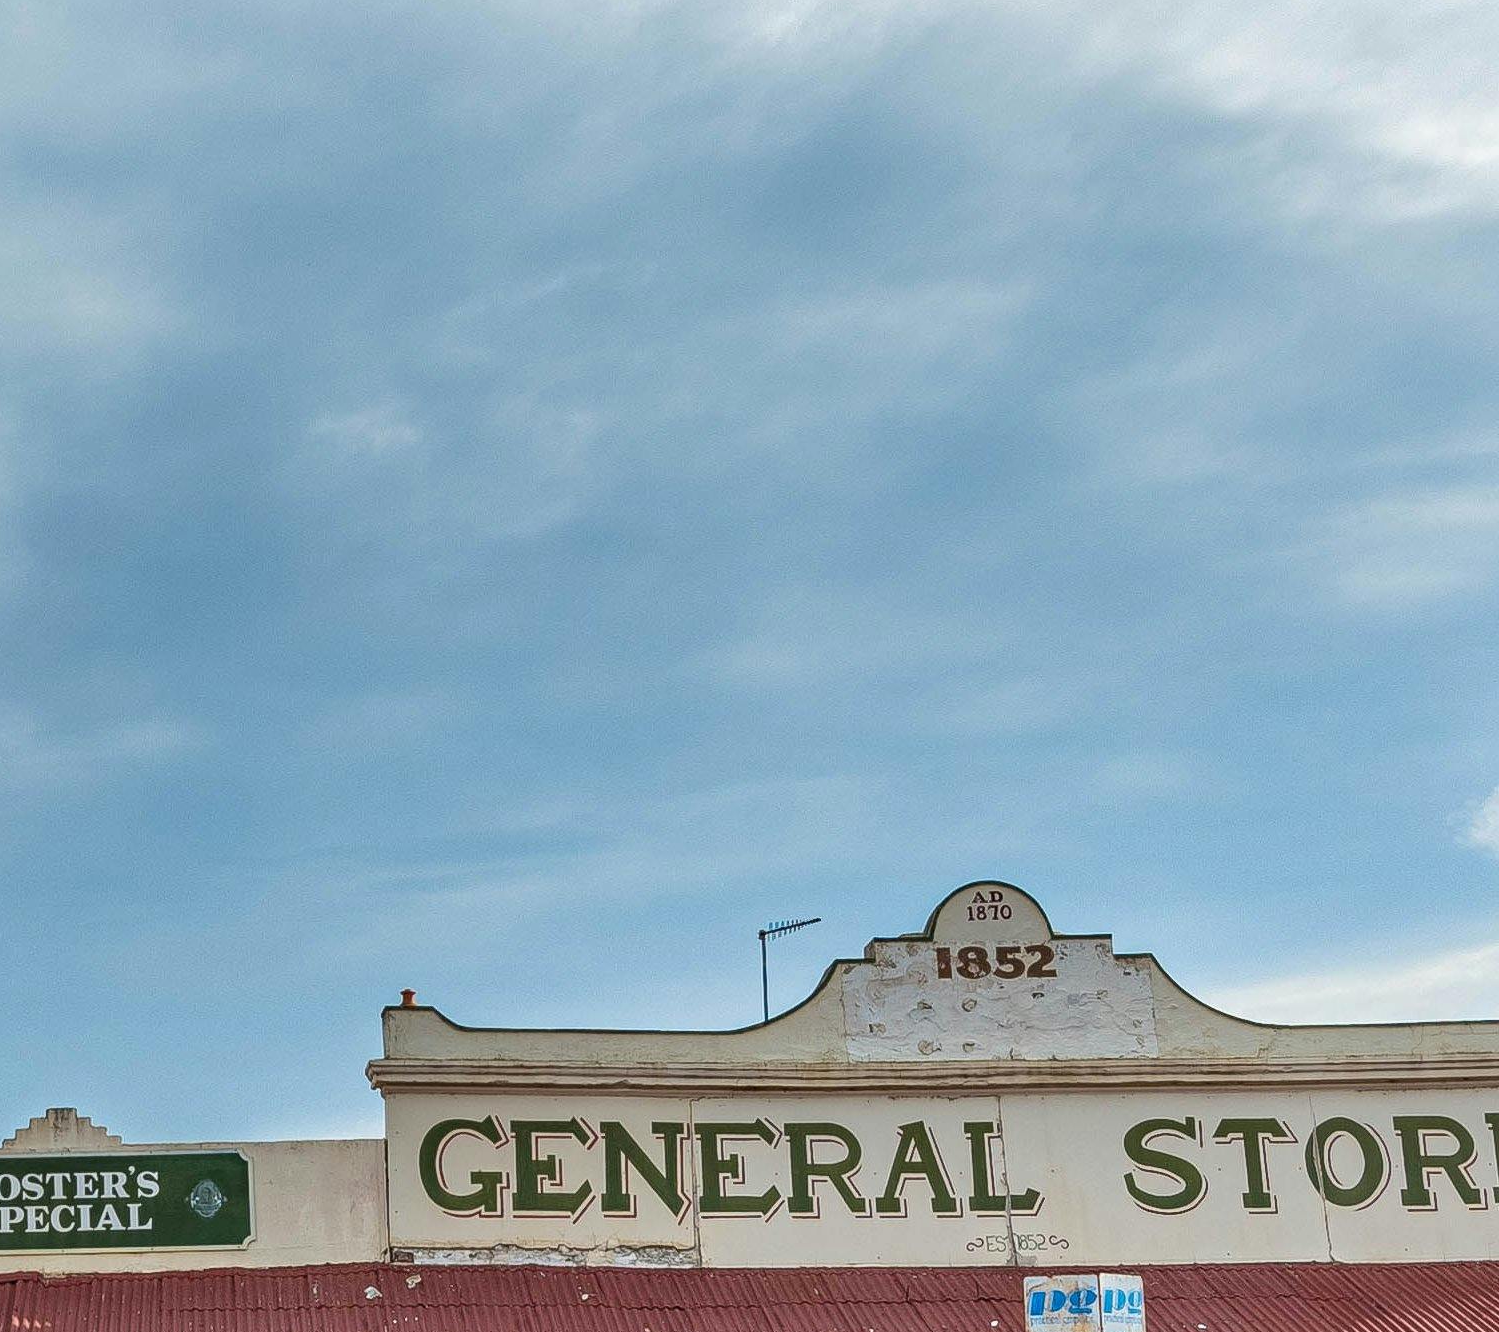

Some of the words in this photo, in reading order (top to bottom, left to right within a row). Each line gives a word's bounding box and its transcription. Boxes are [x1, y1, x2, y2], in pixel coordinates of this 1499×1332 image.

[966, 904, 1013, 922] 1870
[935, 944, 1058, 980] 1852
[418, 1114, 1043, 1220] GENERAL
